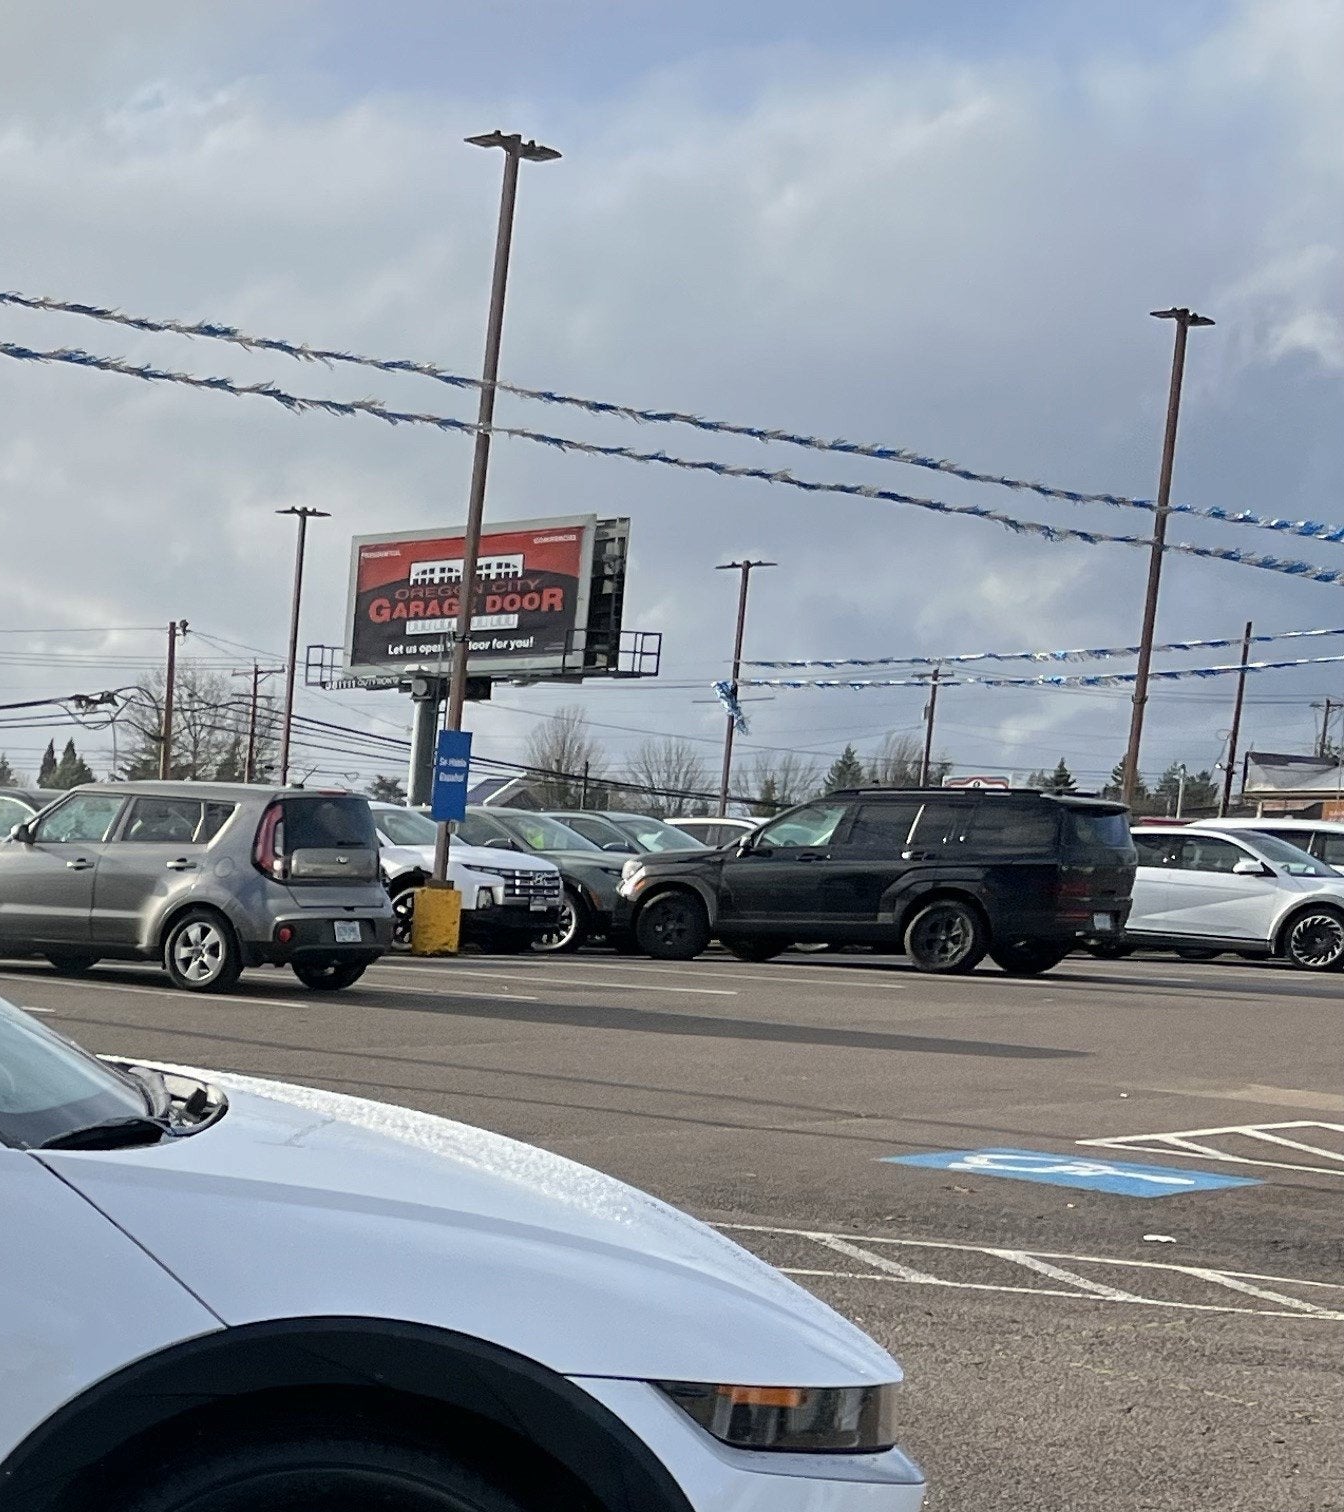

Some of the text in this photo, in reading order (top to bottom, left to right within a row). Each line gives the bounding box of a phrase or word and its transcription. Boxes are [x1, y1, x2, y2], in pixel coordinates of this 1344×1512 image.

[492, 578, 542, 593] CITY
[368, 587, 564, 624] GARAG DOOR
[388, 644, 404, 655] Let
[406, 644, 417, 654] us
[419, 643, 445, 655] open
[492, 638, 508, 649] for
[509, 636, 534, 651] you!
